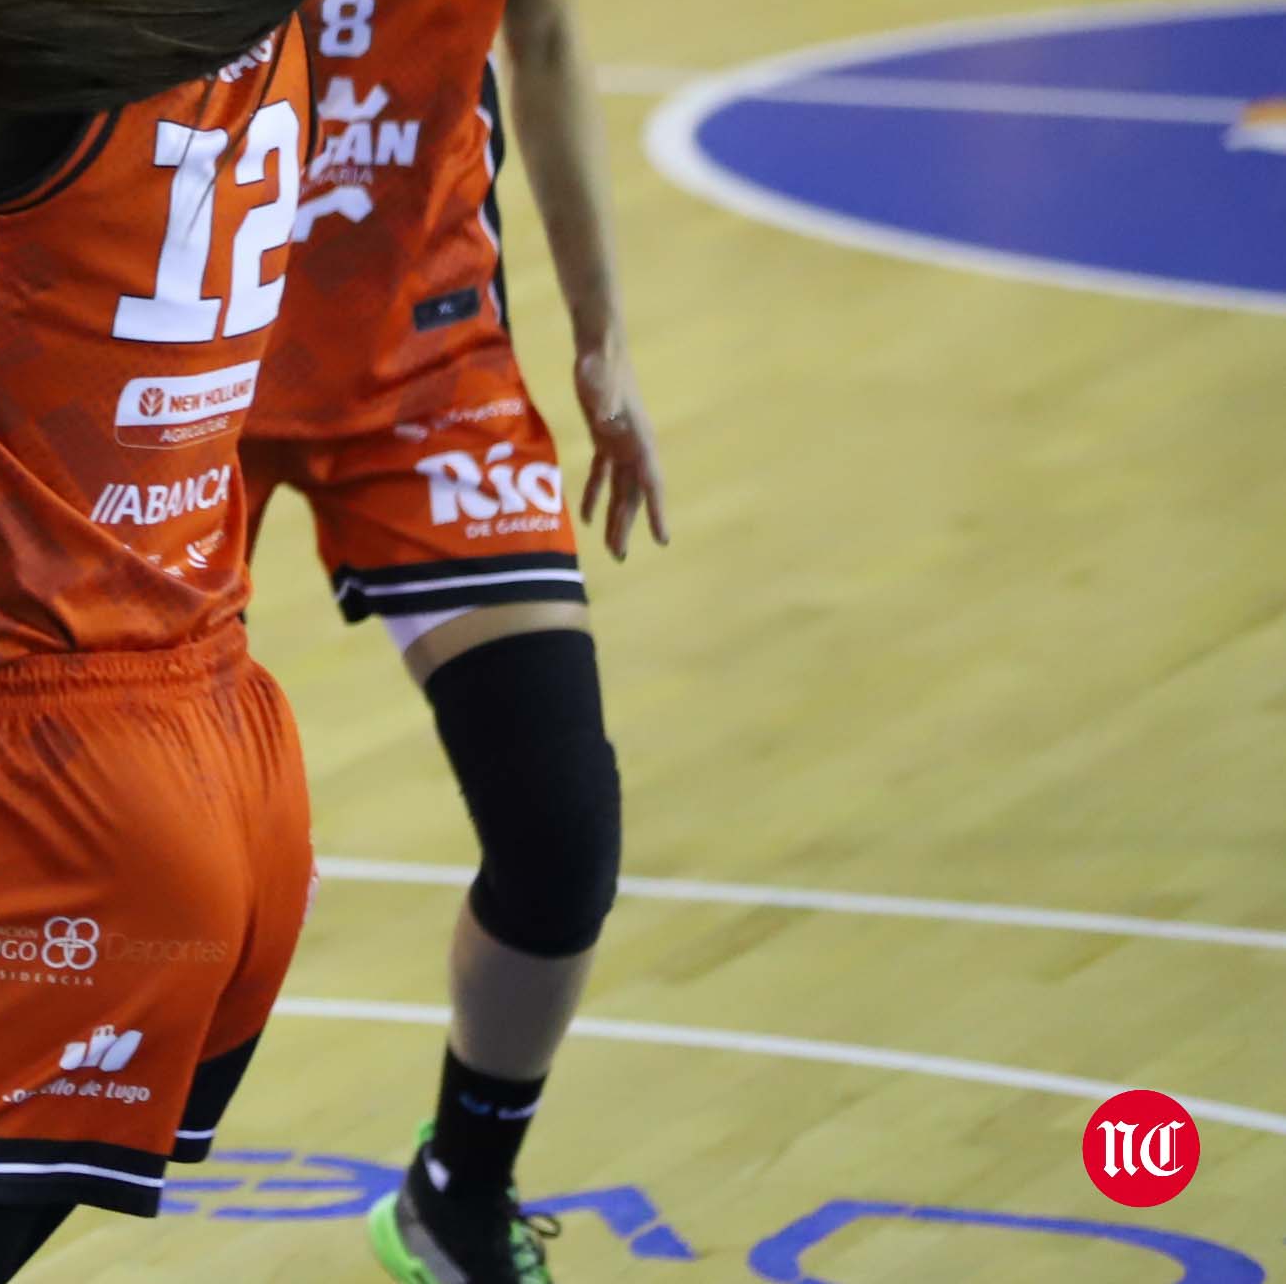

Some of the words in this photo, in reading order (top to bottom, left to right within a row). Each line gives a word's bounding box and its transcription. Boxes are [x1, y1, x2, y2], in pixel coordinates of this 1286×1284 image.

[111, 98, 300, 344] 12
[169, 394, 201, 414] NEW
[413, 441, 563, 527] Río
[78, 1079, 102, 1097] de
[106, 1081, 151, 1104] Lugo
